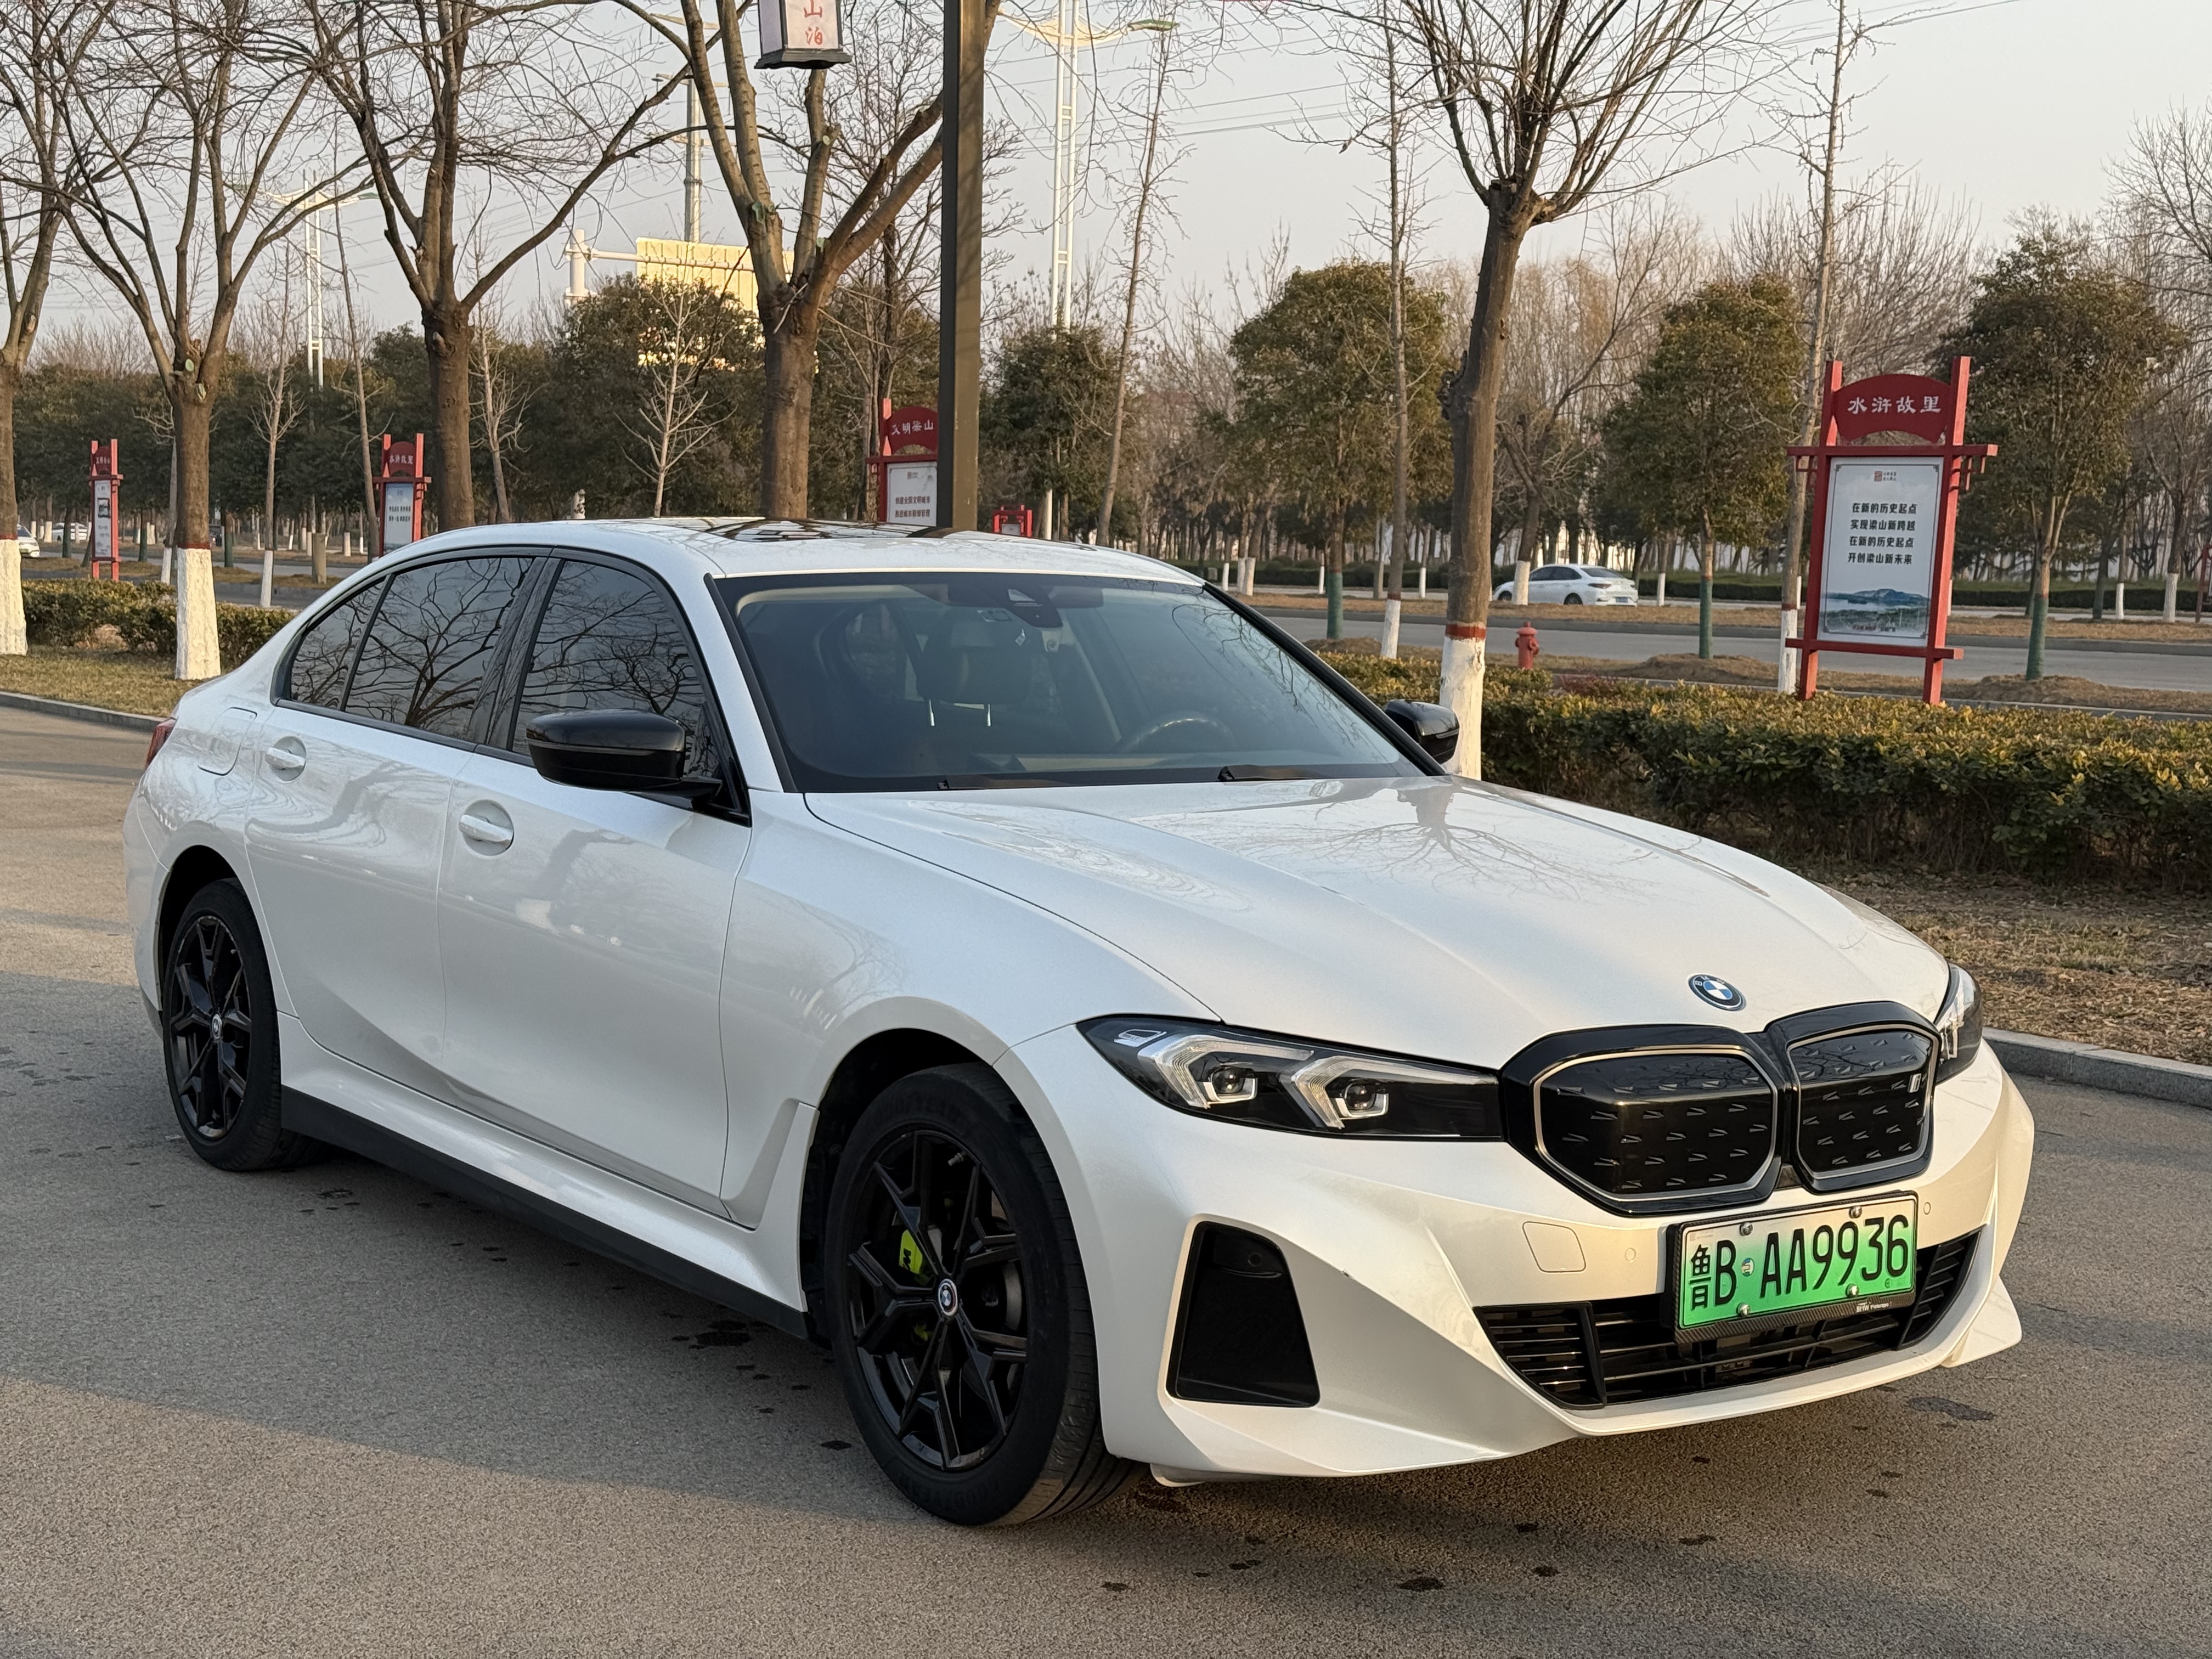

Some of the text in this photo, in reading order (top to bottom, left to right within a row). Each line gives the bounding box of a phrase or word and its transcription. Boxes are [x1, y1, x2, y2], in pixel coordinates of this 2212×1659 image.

[1847, 395, 1941, 415] 水浒故里
[891, 419, 934, 436] 文明梁山
[1852, 503, 1917, 515] 在新的历史起点
[1850, 520, 1916, 531] 实现梁山新跨越
[1849, 536, 1914, 548] 在新的历史起点
[1847, 552, 1912, 565] 开创梁山新未来
